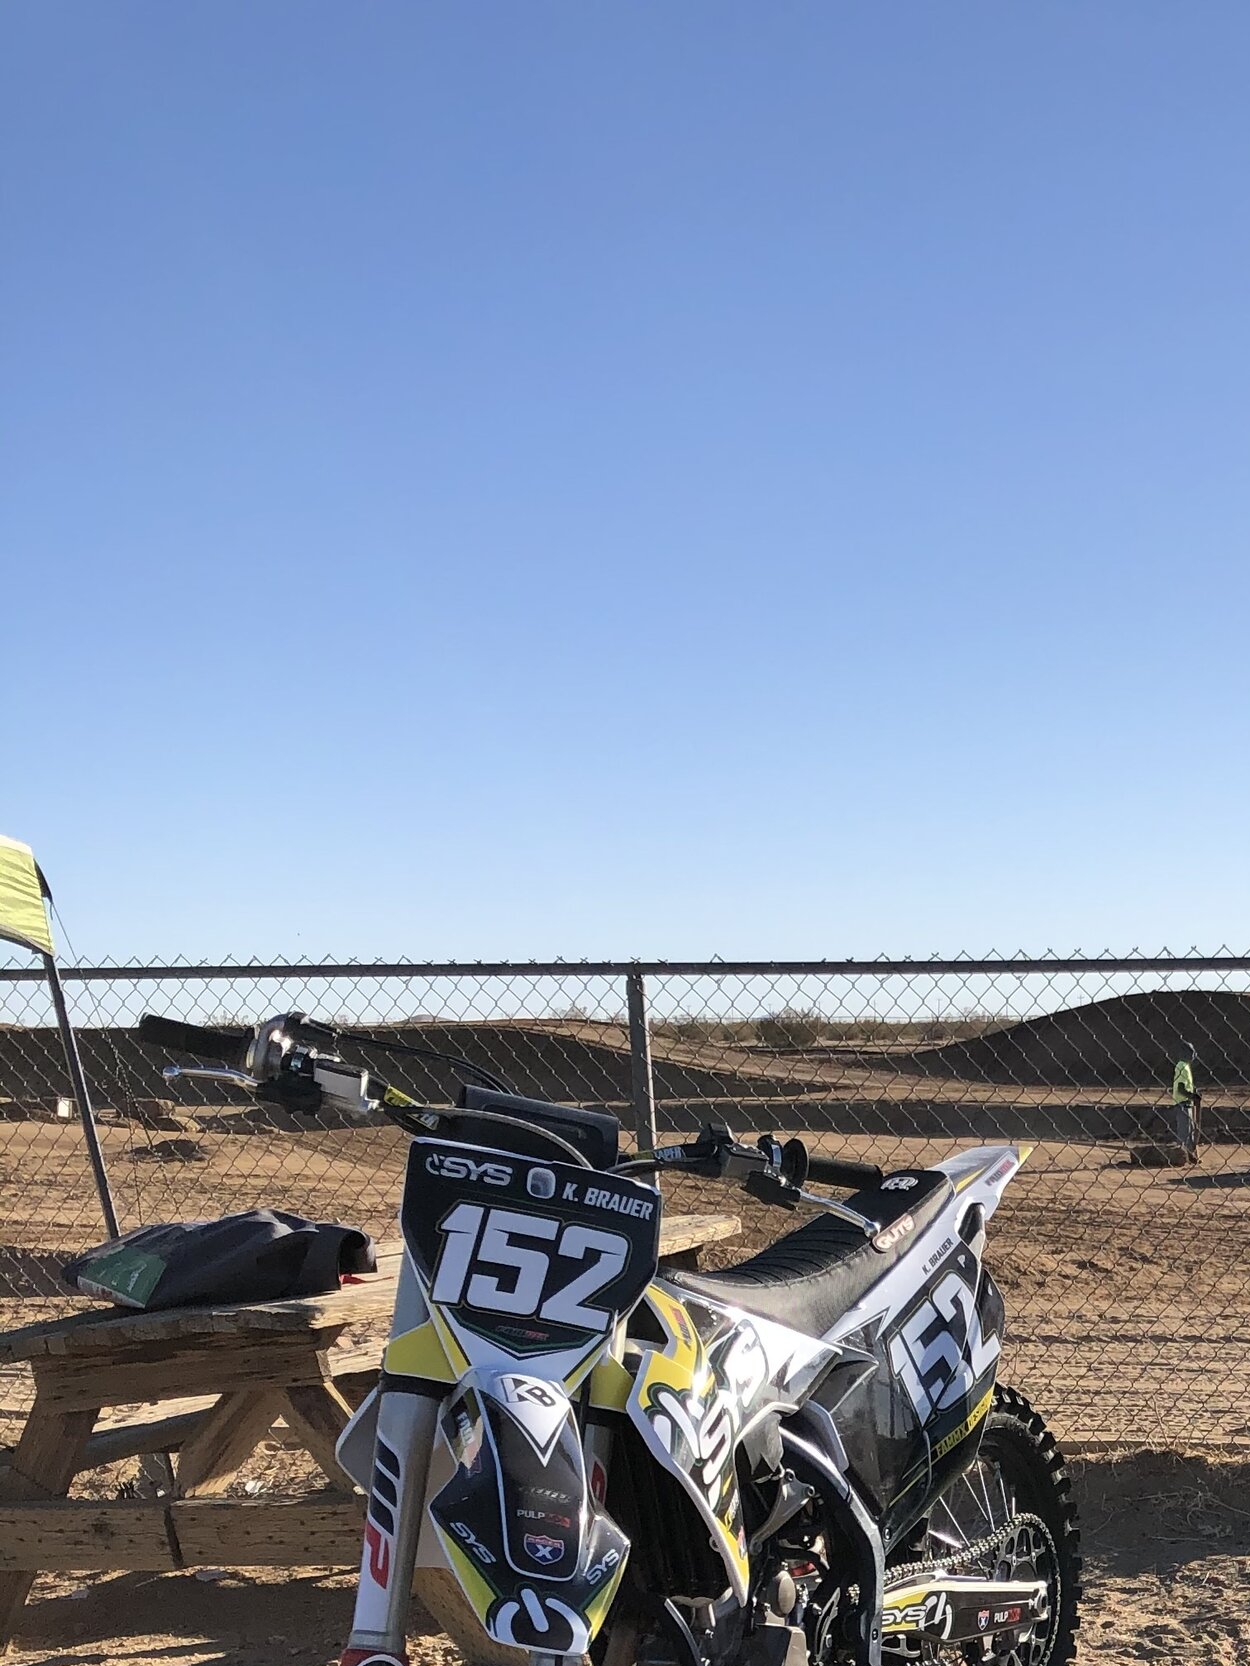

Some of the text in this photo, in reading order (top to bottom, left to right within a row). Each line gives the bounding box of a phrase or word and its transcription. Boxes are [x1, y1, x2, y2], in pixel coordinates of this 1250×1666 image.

[561, 1182, 654, 1221] K. BRAUER
[432, 1203, 630, 1332] 152
[928, 1237, 954, 1267] BRAUER
[500, 1376, 556, 1407] KB
[450, 1521, 497, 1564] SYS
[585, 1549, 619, 1586] SYS
